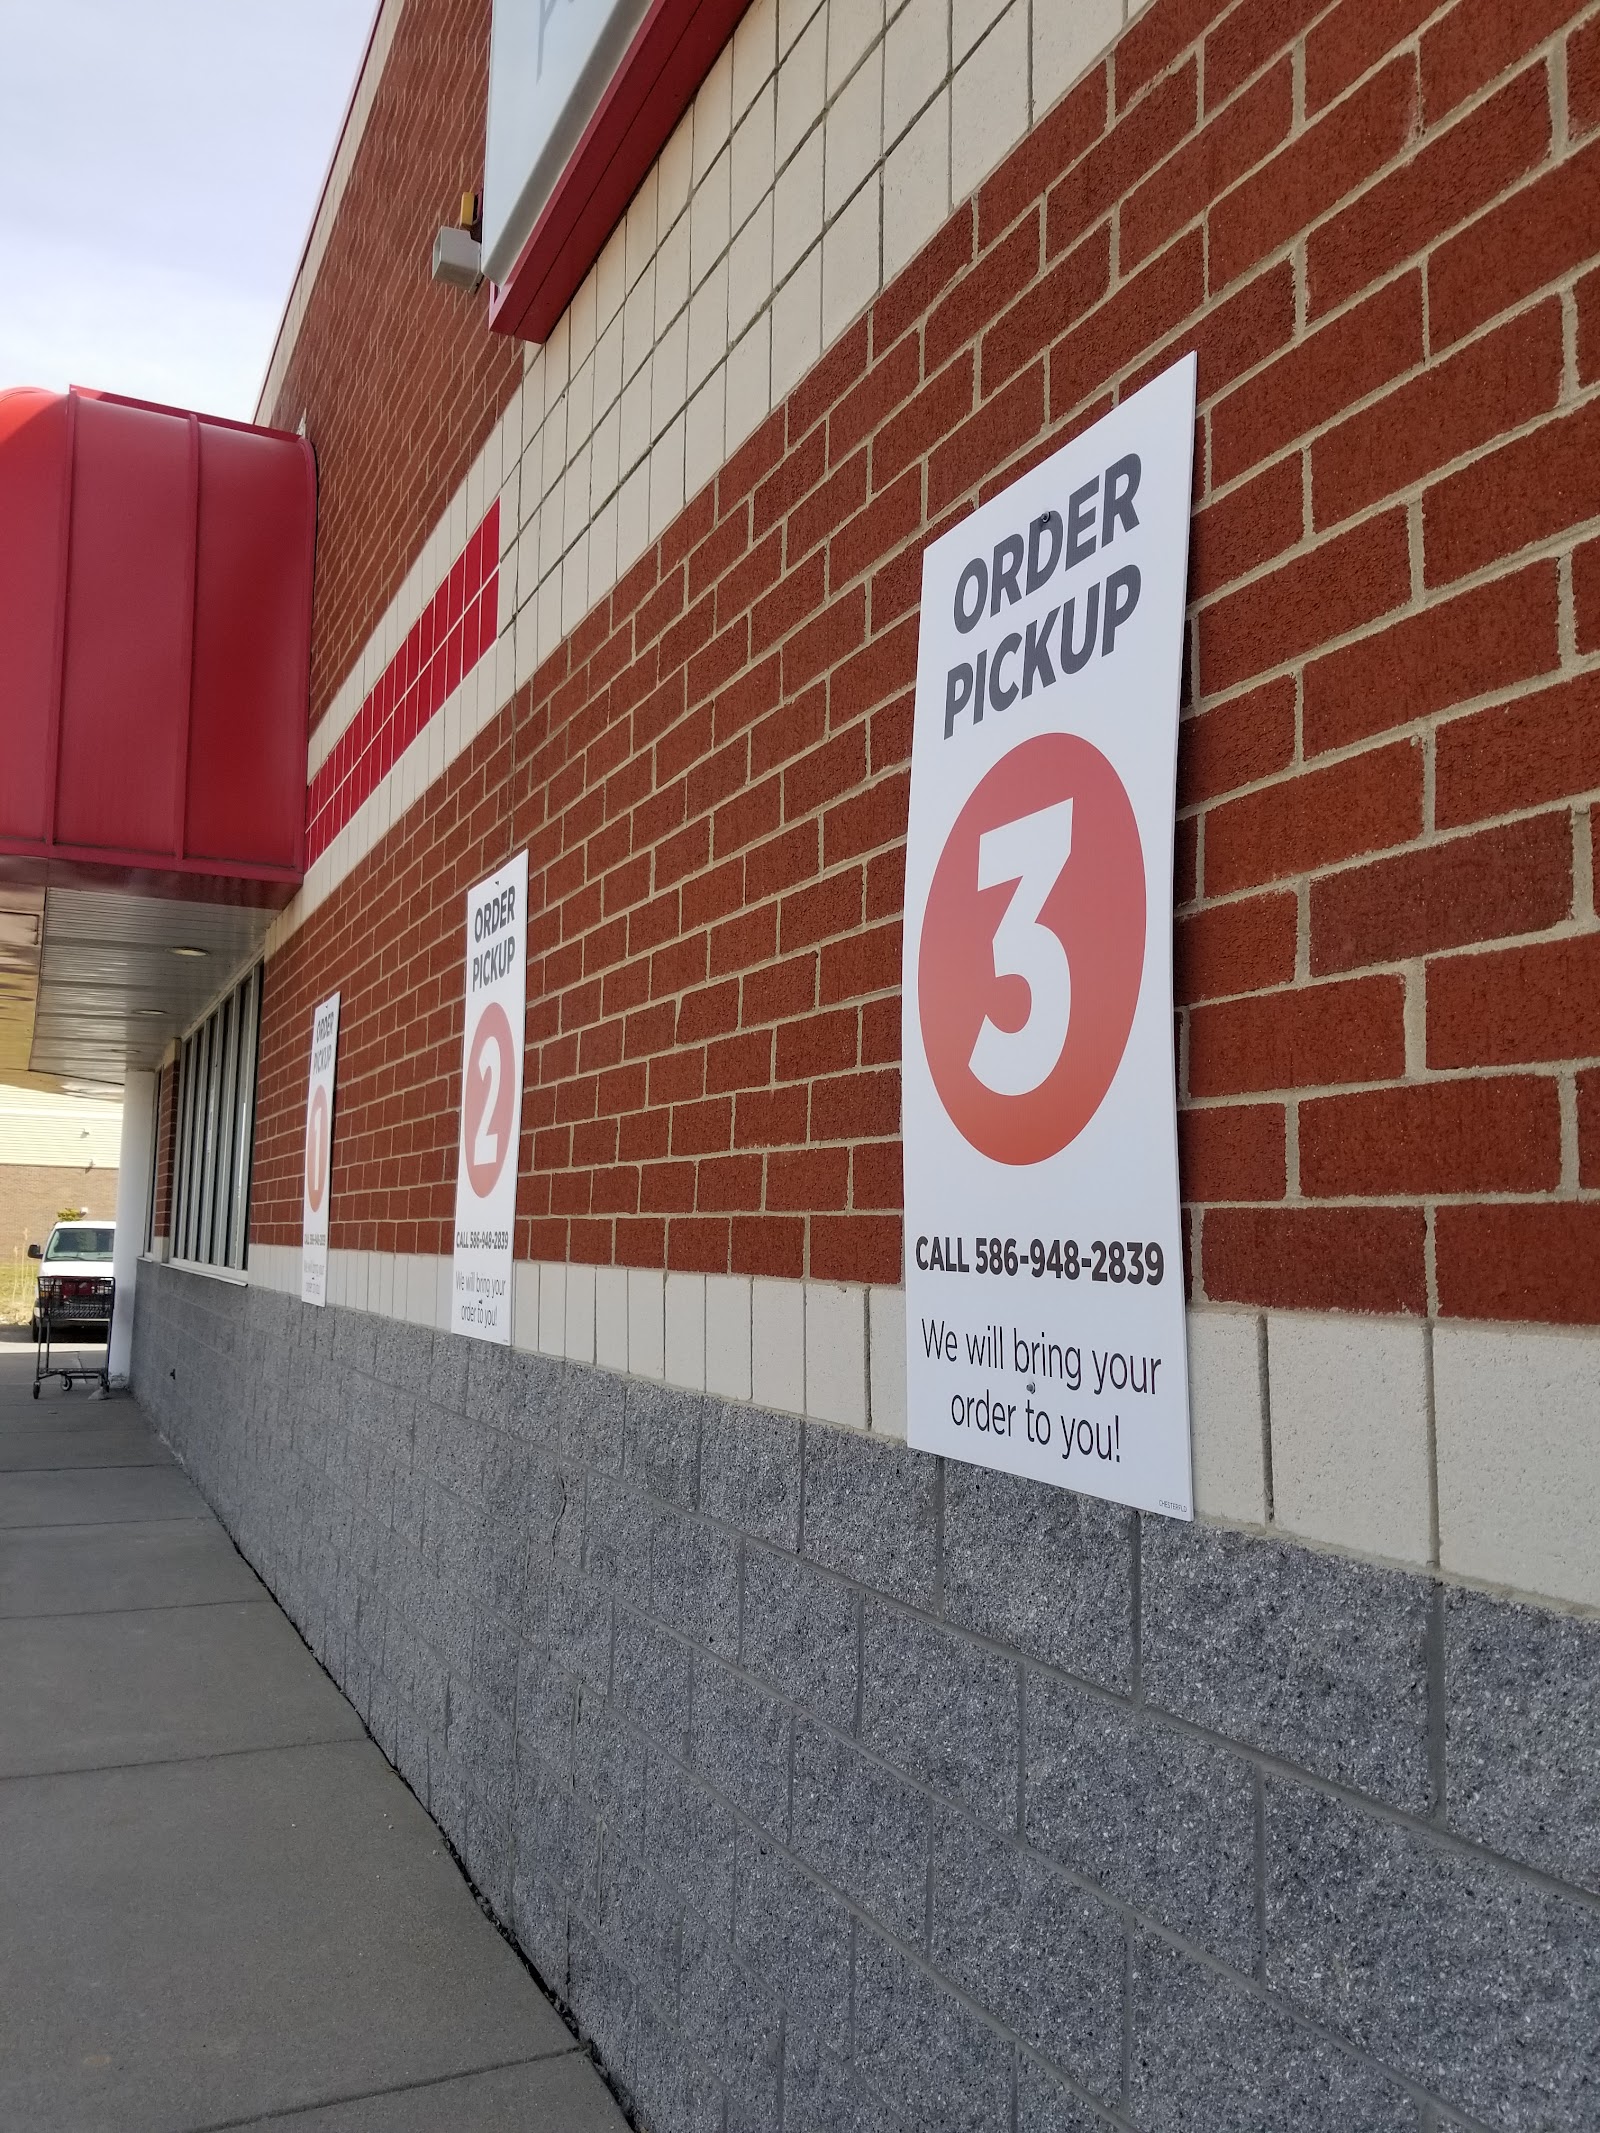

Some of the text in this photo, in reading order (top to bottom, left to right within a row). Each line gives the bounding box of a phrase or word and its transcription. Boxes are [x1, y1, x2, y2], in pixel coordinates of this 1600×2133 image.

[953, 453, 1142, 634] ORDER
[944, 564, 1142, 740] PICKUP
[474, 885, 516, 943] ORDER
[968, 797, 1074, 1097] 3
[472, 936, 516, 992] PICKUP
[474, 1036, 501, 1166] 2
[456, 1231, 509, 1250] CALL 586-948-2839
[915, 1236, 1165, 1286] CALL 586-948-2839
[461, 1302, 477, 1323] order
[477, 1303, 484, 1324] to
[491, 1279, 506, 1299] your
[921, 1318, 1162, 1395] We will bring your
[951, 1389, 1121, 1463] order to you!
